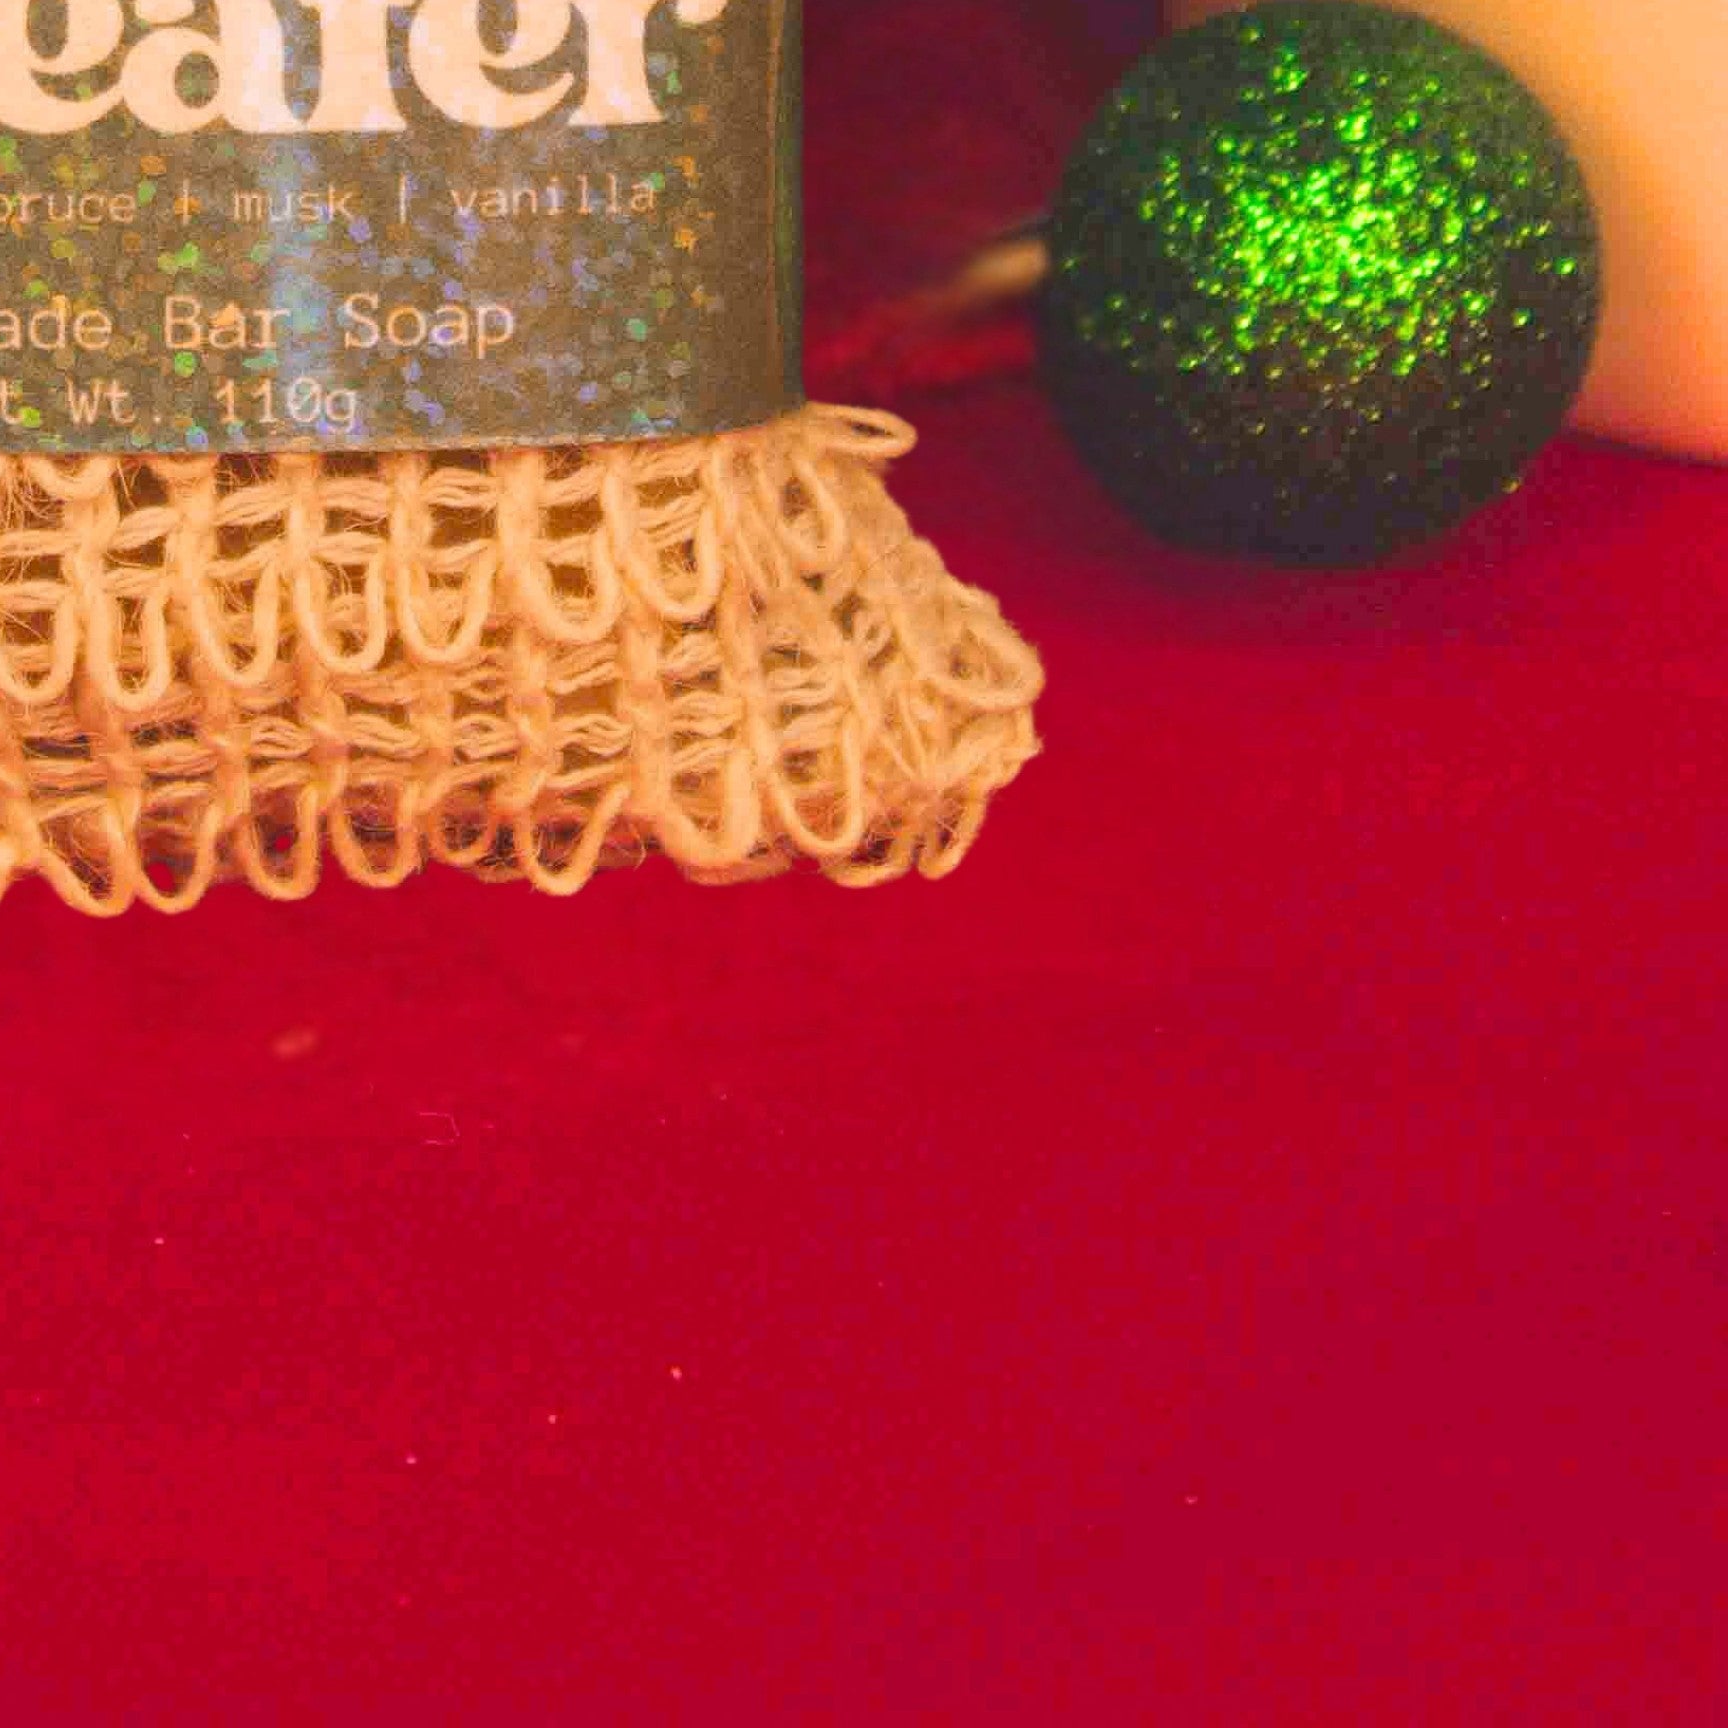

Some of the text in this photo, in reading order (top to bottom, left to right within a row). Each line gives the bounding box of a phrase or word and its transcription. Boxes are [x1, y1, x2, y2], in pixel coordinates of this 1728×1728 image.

[231, 180, 357, 225] musk
[448, 171, 657, 218] vanilla
[163, 294, 291, 351] Bar
[343, 291, 517, 361] Soap
[215, 375, 359, 435] 110g
